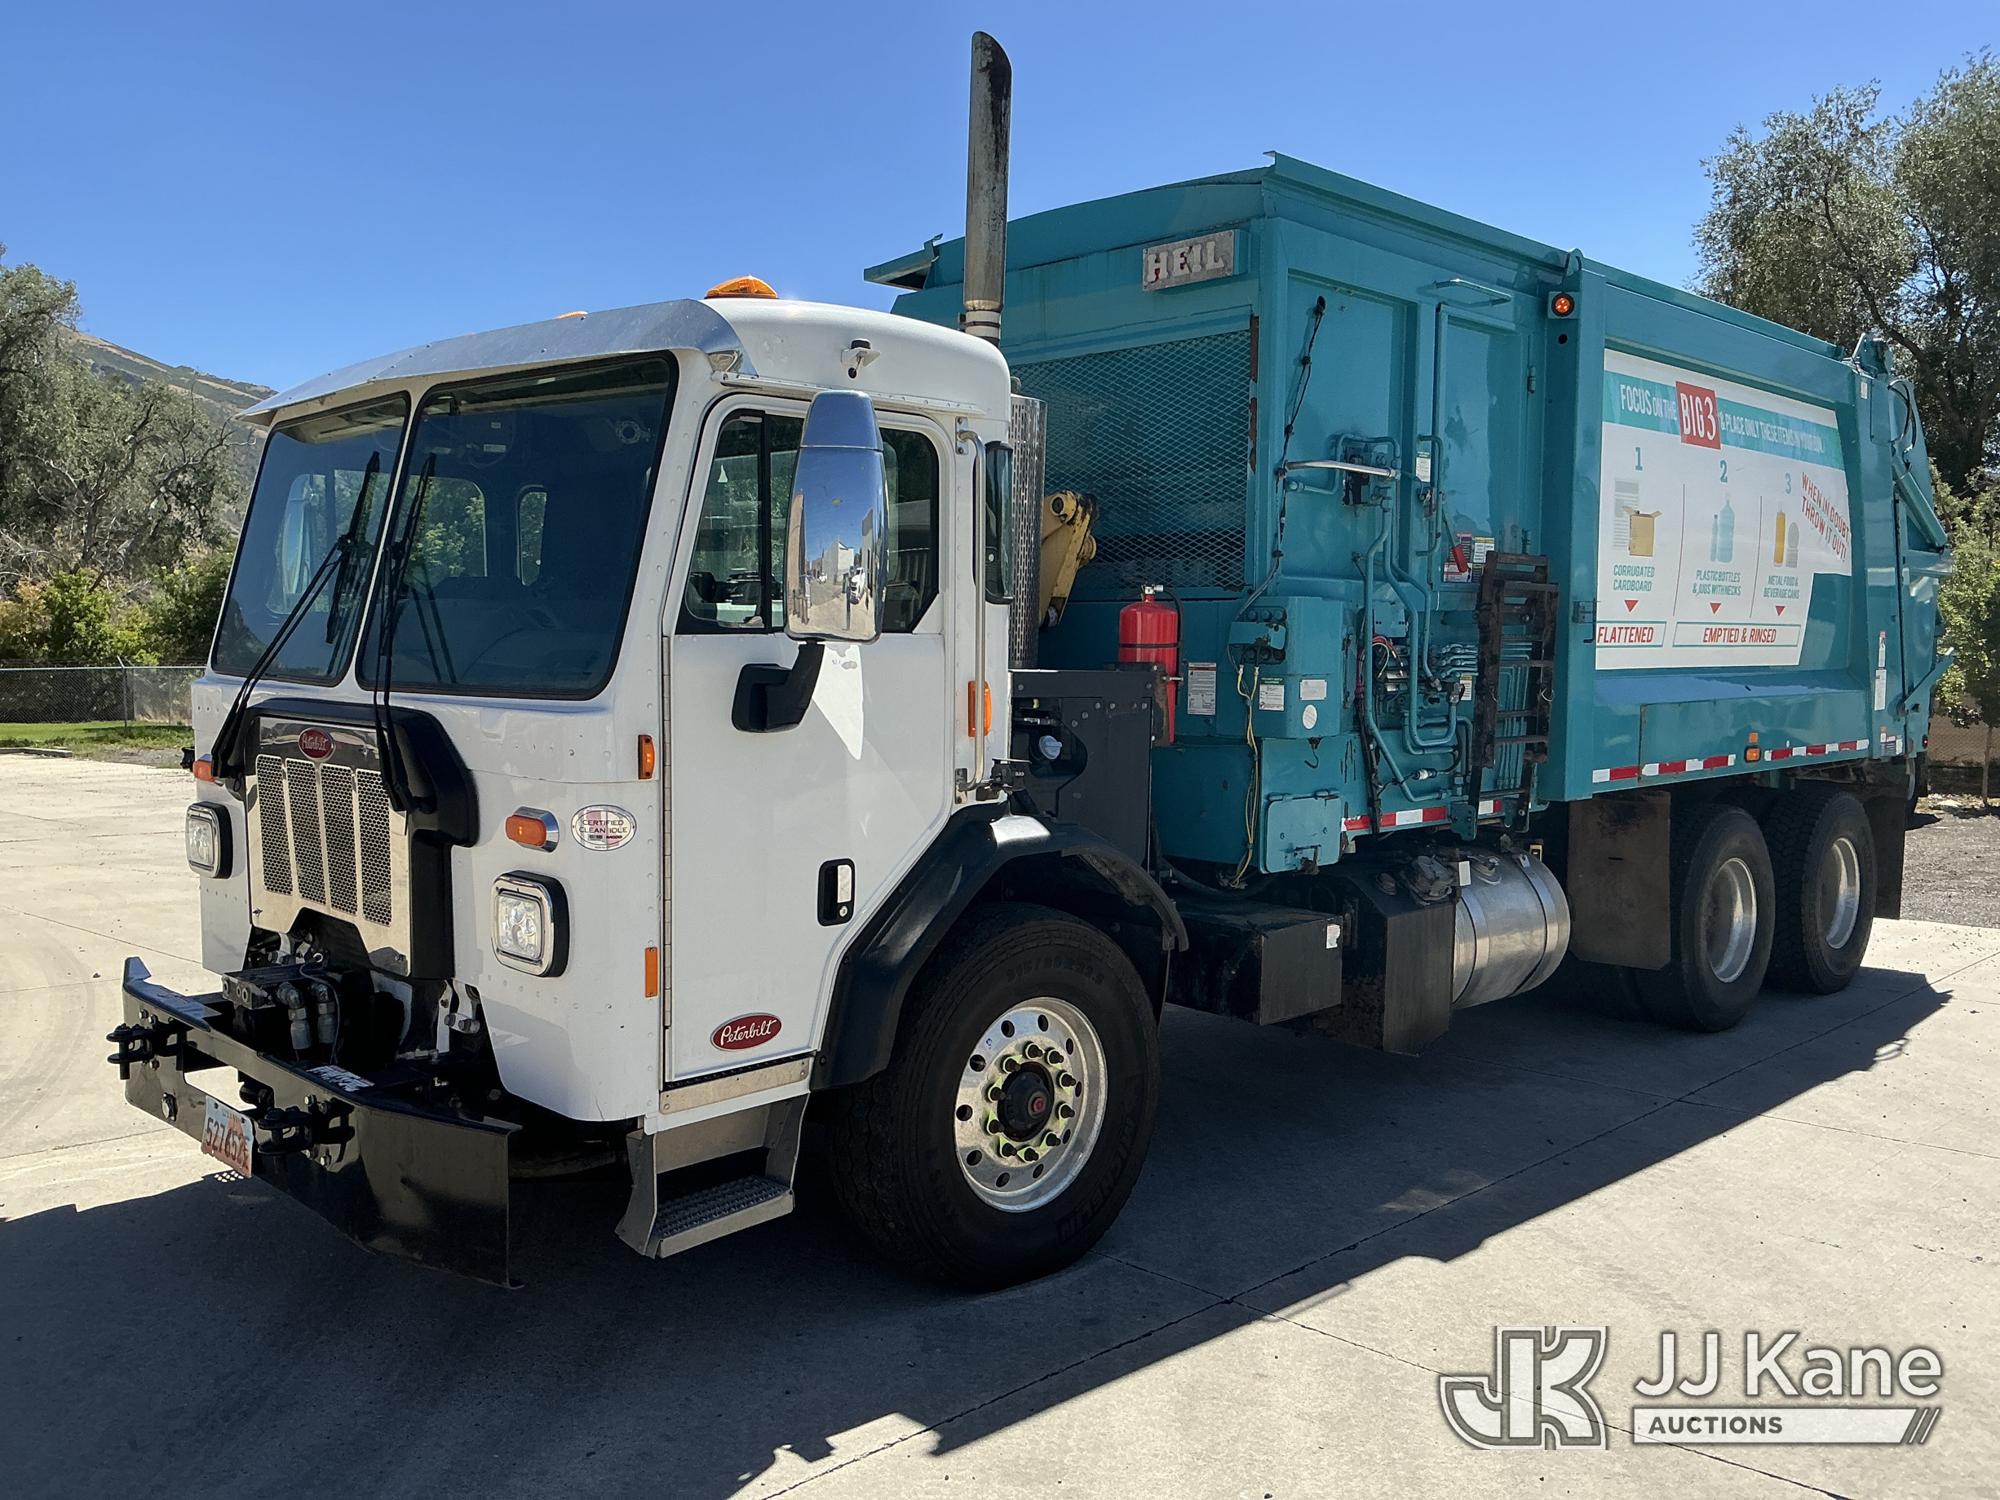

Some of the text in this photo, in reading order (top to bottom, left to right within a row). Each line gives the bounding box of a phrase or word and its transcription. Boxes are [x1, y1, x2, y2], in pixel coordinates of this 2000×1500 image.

[1147, 241, 1225, 282] HEIL
[1620, 384, 1652, 416] FOCUS
[1680, 392, 1717, 440] BIG 3
[1635, 447, 1643, 471] 1
[1720, 460, 1728, 483] 2
[1785, 473, 1792, 494] 3
[1802, 472, 1822, 509] WHEN
[1822, 496, 1830, 516] IN
[1829, 507, 1850, 543] DOUBT
[1802, 496, 1847, 562] THROW IT OUT!
[1613, 564, 1655, 577] CORRUGATED
[1613, 579, 1652, 591] CARDBOARD
[1597, 626, 1654, 644] FLATTENED
[1703, 627, 1777, 643] EMPTIED & RINSED
[578, 826, 628, 834] CLEAN IDLE
[720, 1018, 778, 1047] Peterbilt
